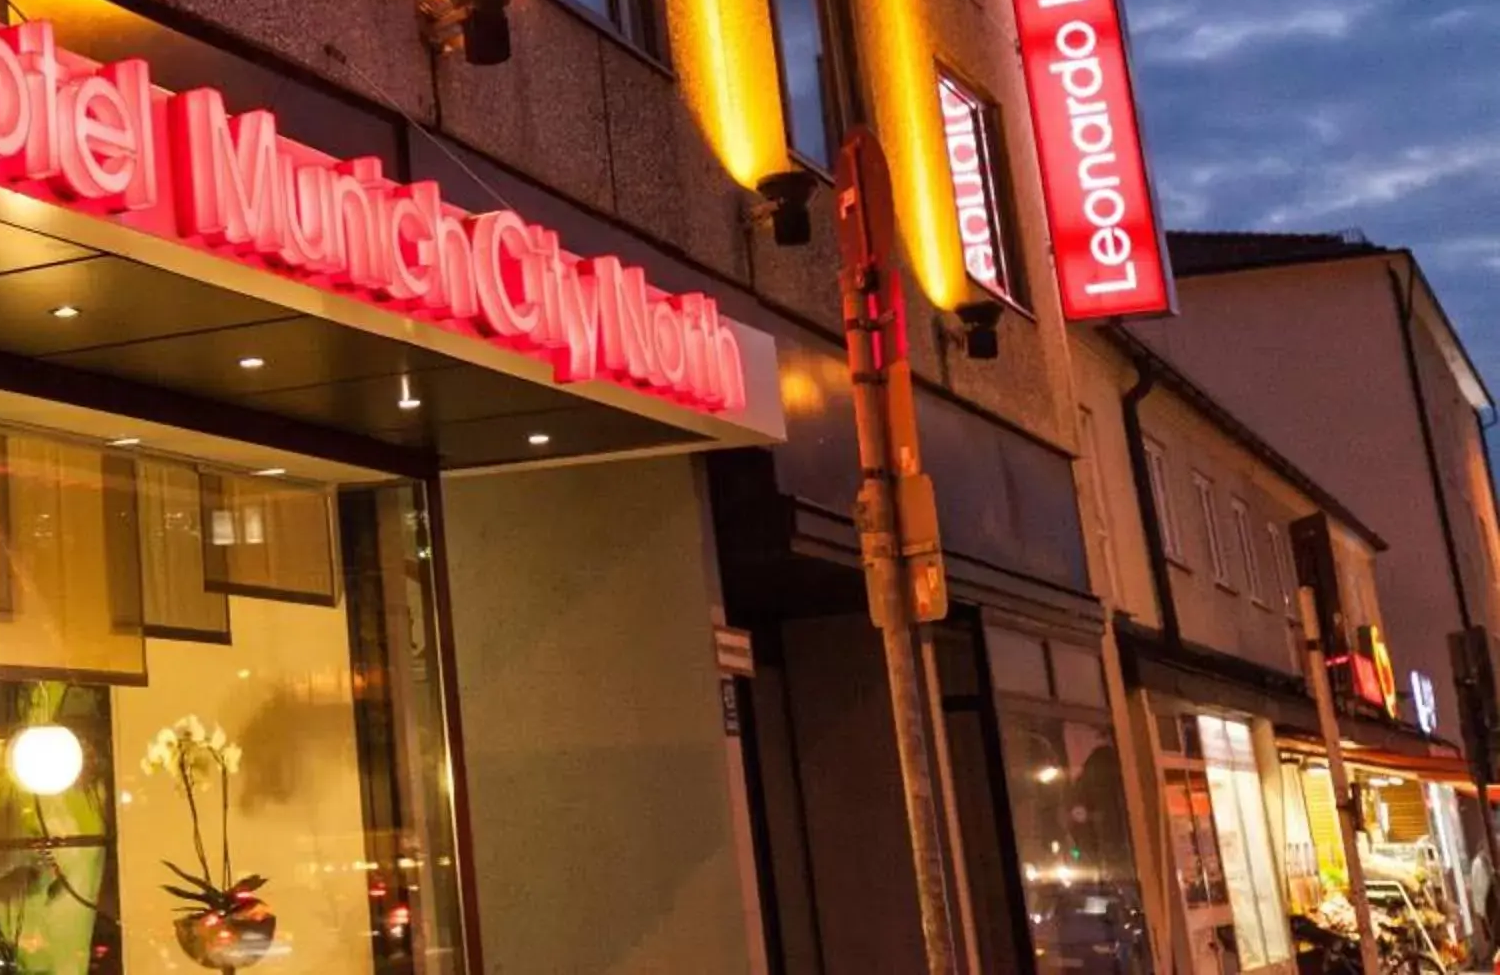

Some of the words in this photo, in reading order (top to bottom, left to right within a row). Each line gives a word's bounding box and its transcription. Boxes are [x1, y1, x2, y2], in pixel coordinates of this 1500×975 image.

[172, 86, 479, 321] Munich
[473, 210, 600, 383] City
[594, 255, 747, 412] North
[1048, 19, 1138, 295] Leonardo
